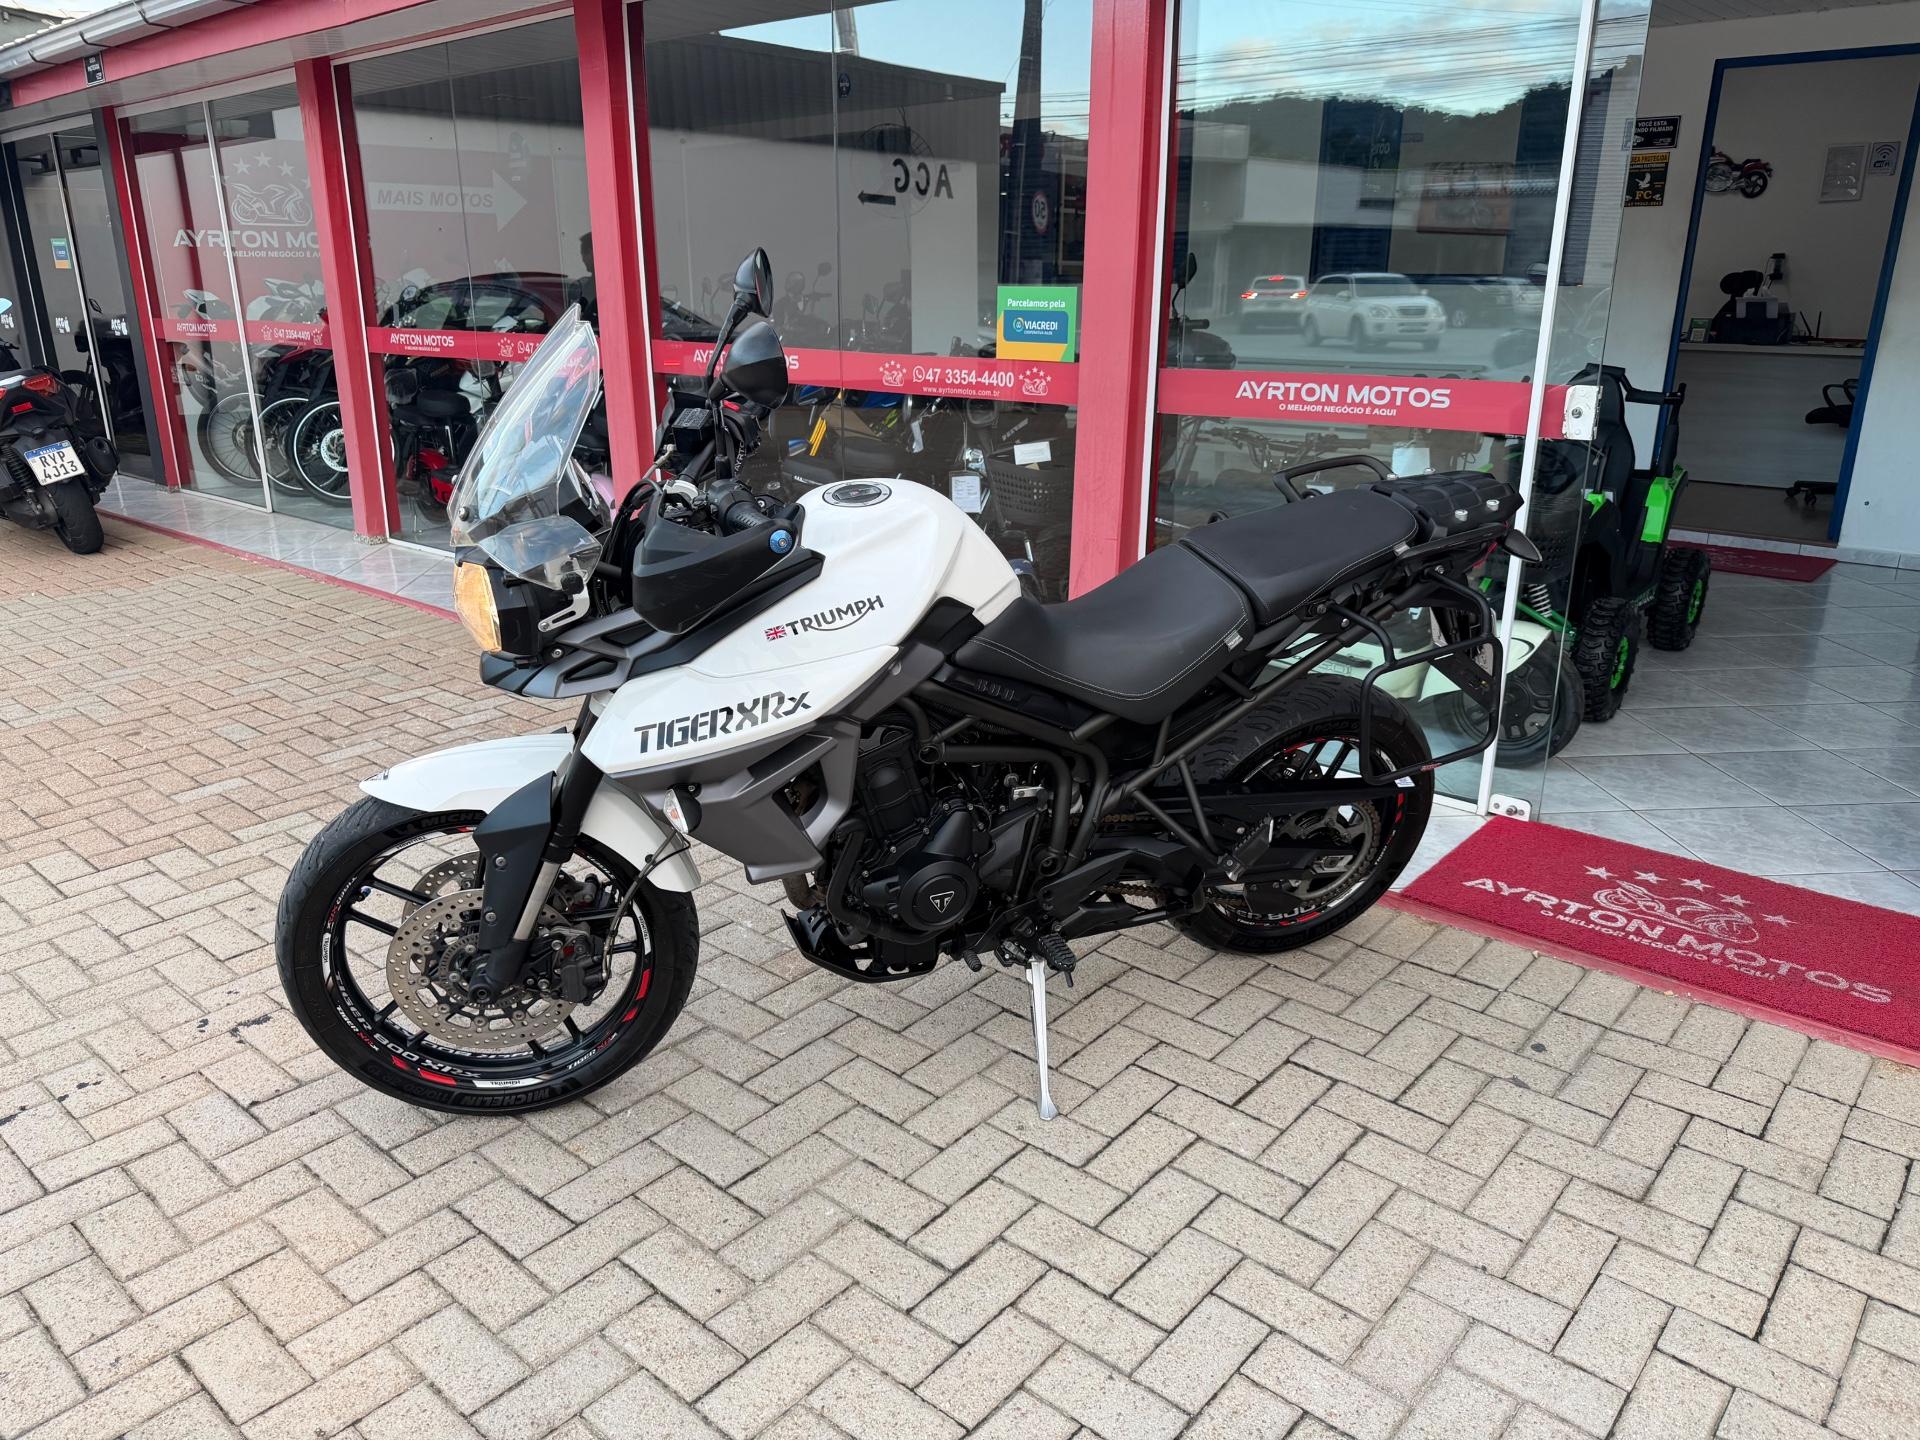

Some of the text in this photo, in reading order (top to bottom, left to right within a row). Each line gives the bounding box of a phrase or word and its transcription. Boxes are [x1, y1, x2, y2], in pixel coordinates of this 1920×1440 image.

[378, 189, 493, 208] MAIS MOTOS
[173, 229, 279, 249] AYRTON
[1007, 299, 1066, 309] Parcelamos pela
[198, 323, 217, 333] MOTOS
[1024, 320, 1058, 330] VIACREDI
[390, 333, 454, 347] AYRTON MOTOS
[525, 343, 535, 354] 47
[926, 368, 1014, 388] 47 3354-4400
[1235, 380, 1451, 409] AYRTON MOTOS
[1287, 404, 1322, 413] MELHOR
[1324, 405, 1364, 415] NEGÓCIO
[1373, 407, 1397, 417] AQUI
[39, 451, 66, 468] RYP
[43, 460, 78, 480] 4J13
[785, 594, 885, 636] TRIUMPH
[1461, 878, 1892, 1003] AYRTON MOTOS
[1556, 914, 1627, 938] MELHOR
[1726, 963, 1777, 981] AQUI
[373, 1032, 420, 1062] 800
[463, 1089, 550, 1108] MICHELIN
